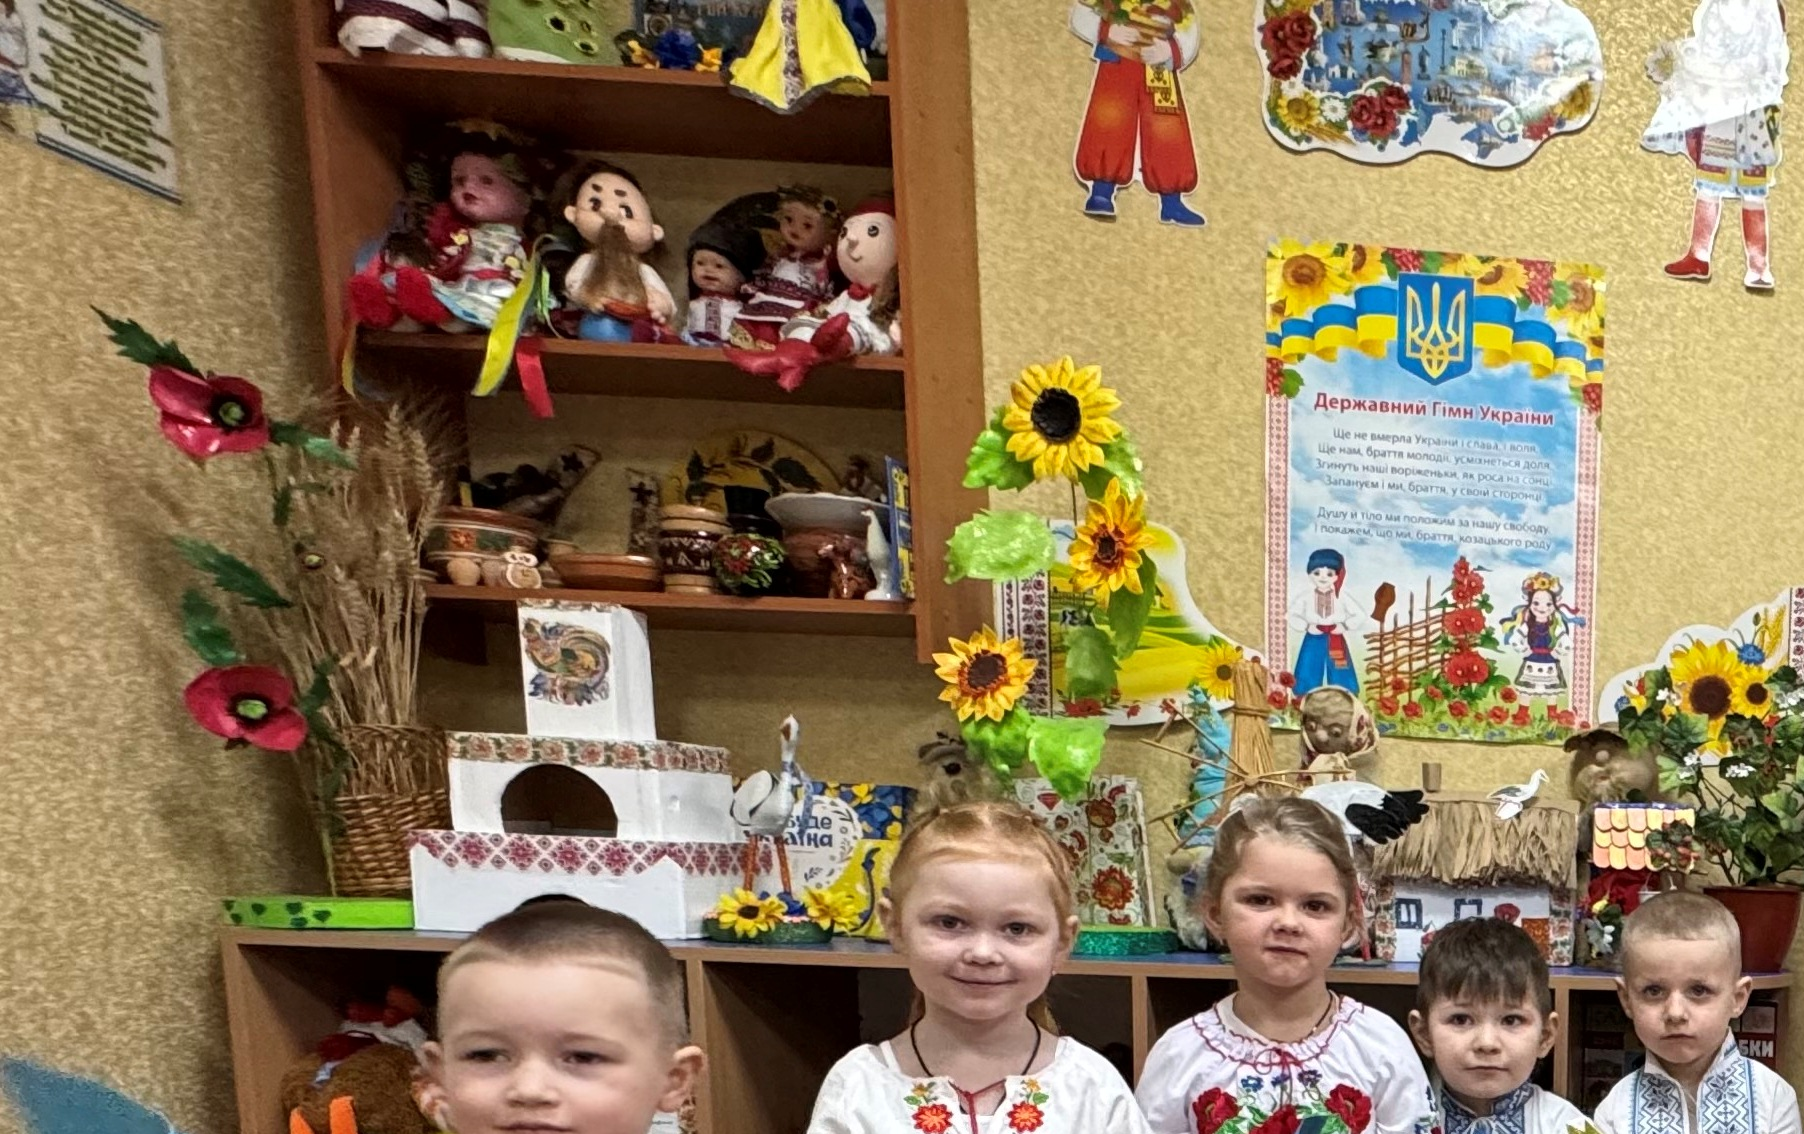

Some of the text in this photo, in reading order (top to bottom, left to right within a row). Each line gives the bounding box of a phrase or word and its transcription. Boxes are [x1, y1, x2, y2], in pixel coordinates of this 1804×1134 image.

[1314, 392, 1553, 425] Державний Гімн України
[1333, 427, 1351, 440] Ще
[1354, 432, 1368, 441] не
[1371, 433, 1412, 444] вмерла
[1415, 434, 1459, 447] України
[1318, 442, 1336, 455] Ще
[1366, 445, 1403, 459] браття
[1316, 458, 1359, 472] Згинуть
[1362, 463, 1388, 473] наші
[1463, 472, 1475, 480] як
[1478, 473, 1504, 484] роса
[1324, 475, 1379, 490] Запануєм
[1317, 506, 1348, 519] Душу
[1361, 511, 1383, 522] тіло
[1385, 514, 1400, 522] ми
[1404, 515, 1455, 526] положим
[1458, 519, 1470, 528] за
[1472, 520, 1501, 532] нашу
[1376, 529, 1393, 539] що
[1459, 535, 1522, 546] козацького
